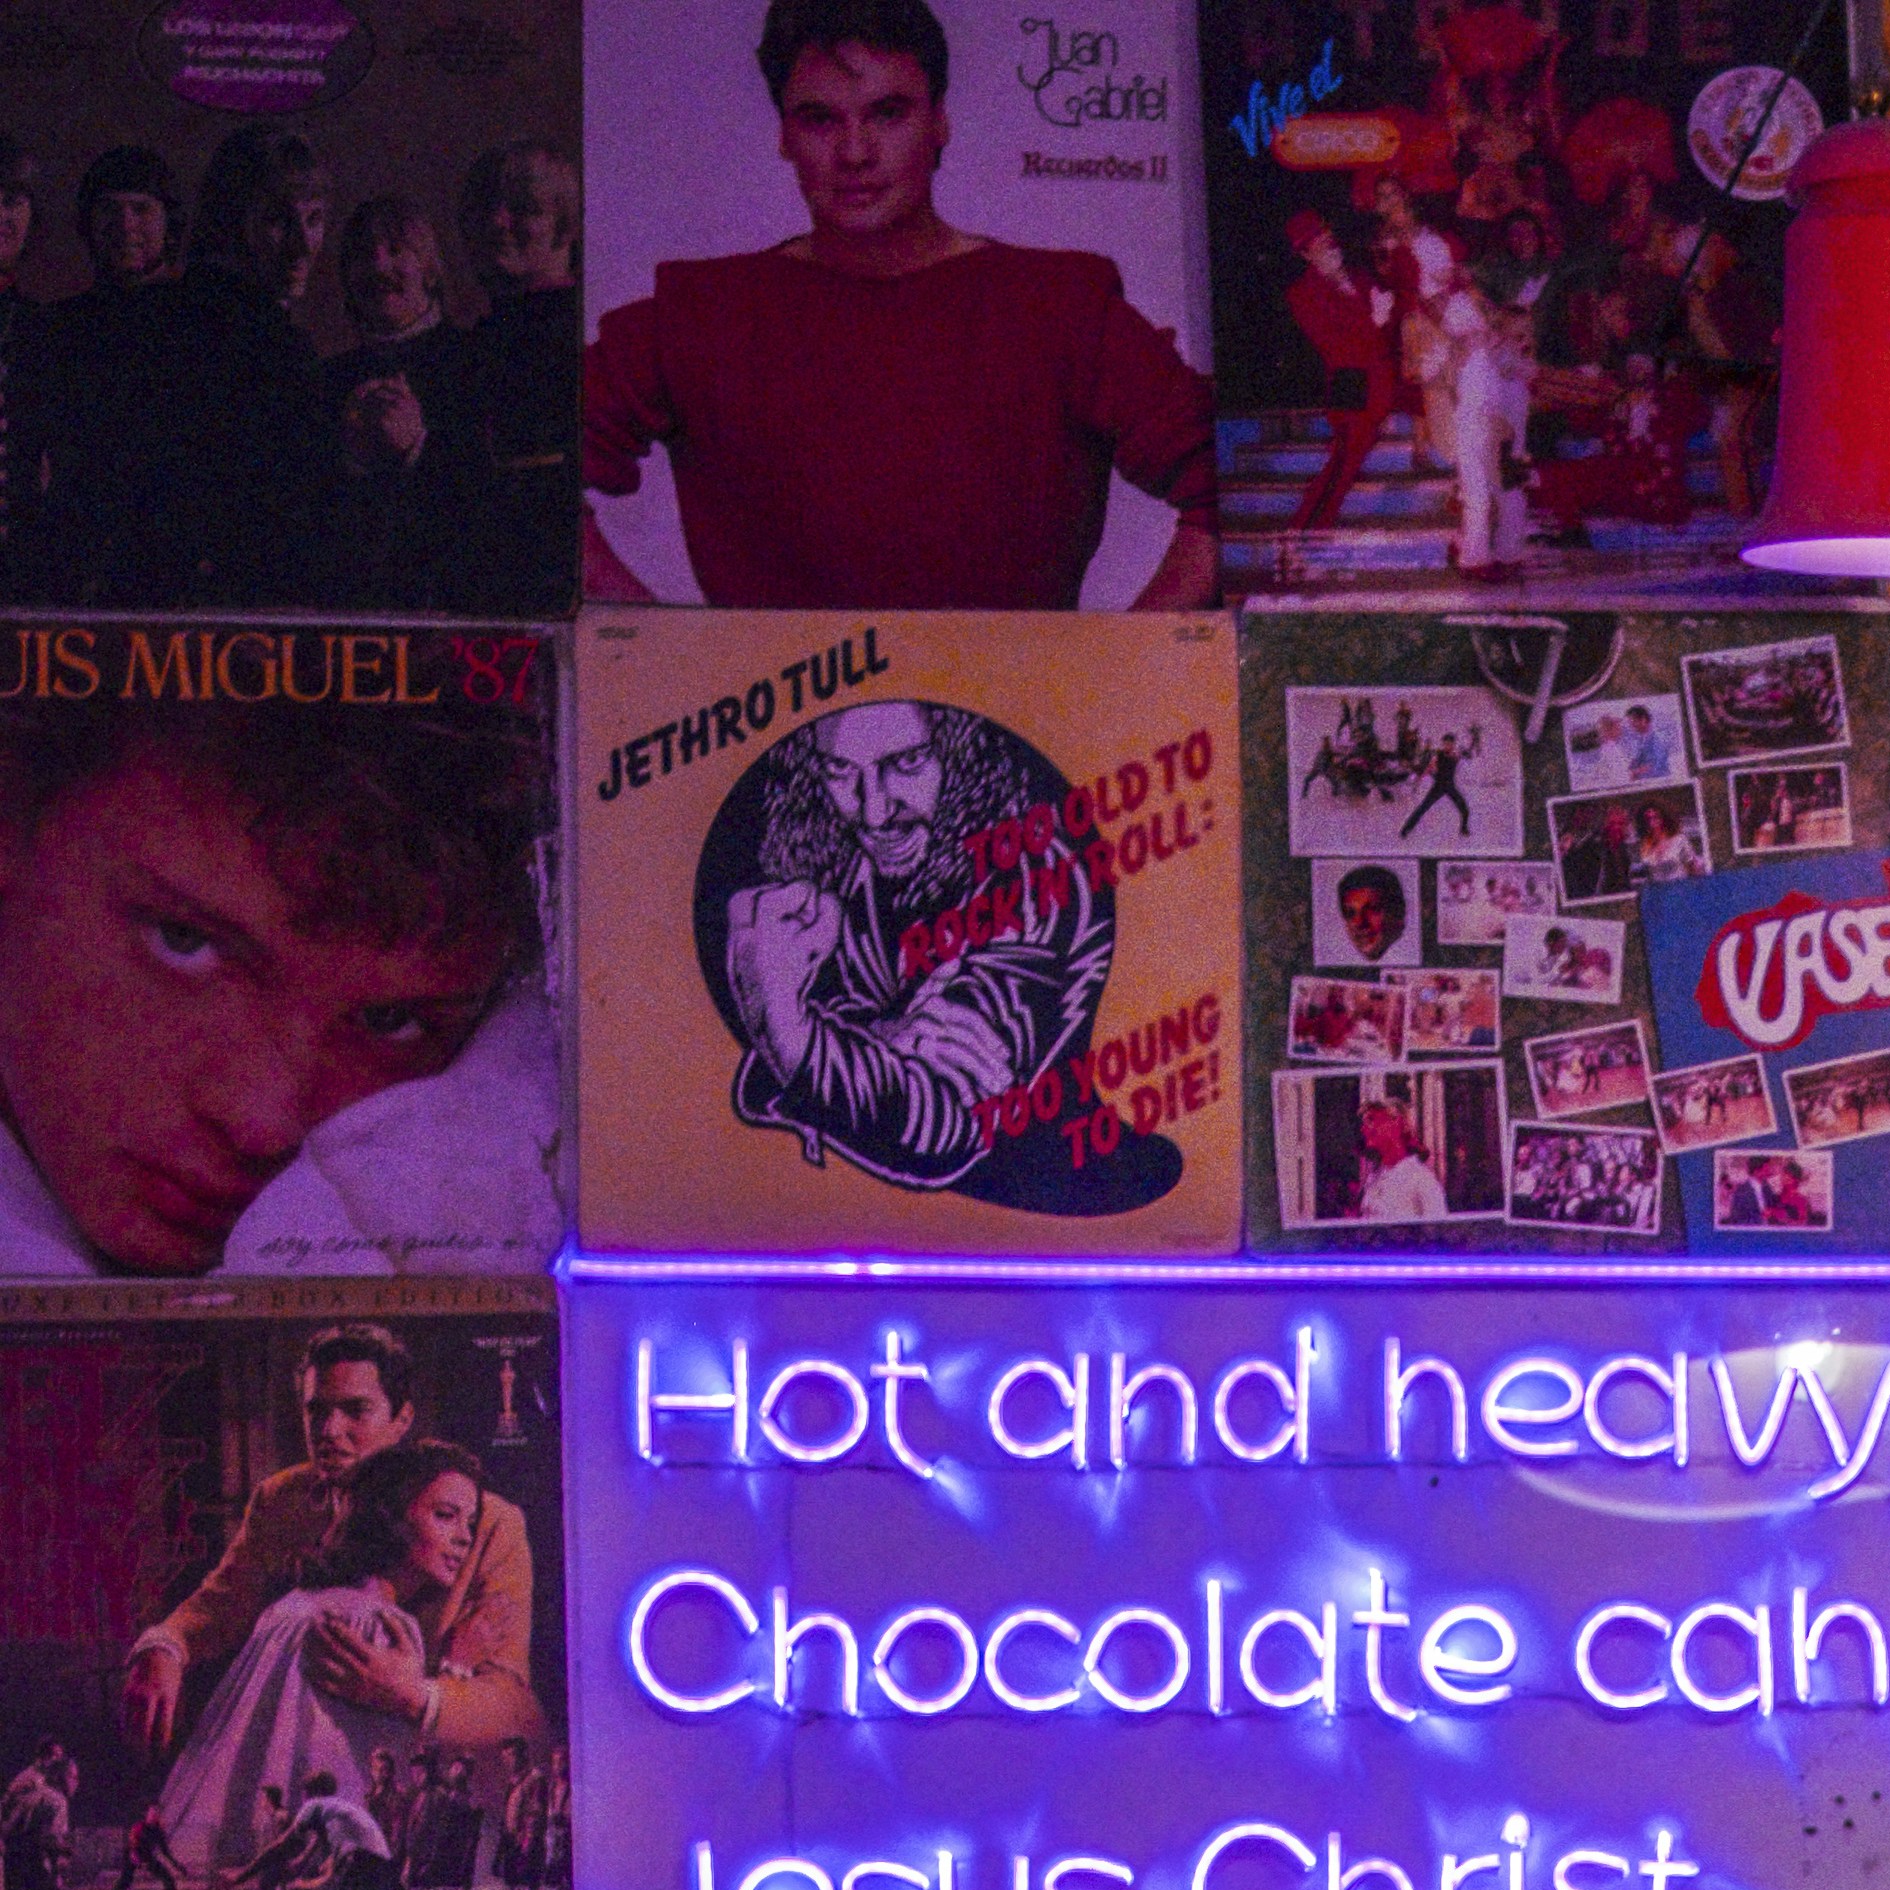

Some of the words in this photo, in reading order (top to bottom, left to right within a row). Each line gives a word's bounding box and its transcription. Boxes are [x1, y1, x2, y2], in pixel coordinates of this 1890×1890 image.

[1017, 17, 1120, 90] Juan
[1035, 66, 1167, 128] Gabriel
[123, 634, 443, 707] MIGUEL
[598, 672, 773, 799] JETHRO
[773, 627, 890, 723] TULL
[962, 802, 1055, 884] TOO
[1063, 761, 1149, 838] OLD
[1153, 728, 1212, 794] TO
[968, 1065, 1066, 1156] TOO
[1070, 993, 1223, 1110] YOUNG
[1058, 1105, 1124, 1172] TO
[1124, 1064, 1223, 1144] DIE!
[636, 1325, 938, 1480] Hot
[986, 1324, 1313, 1473] and
[629, 1566, 1519, 1728] Chocolate
